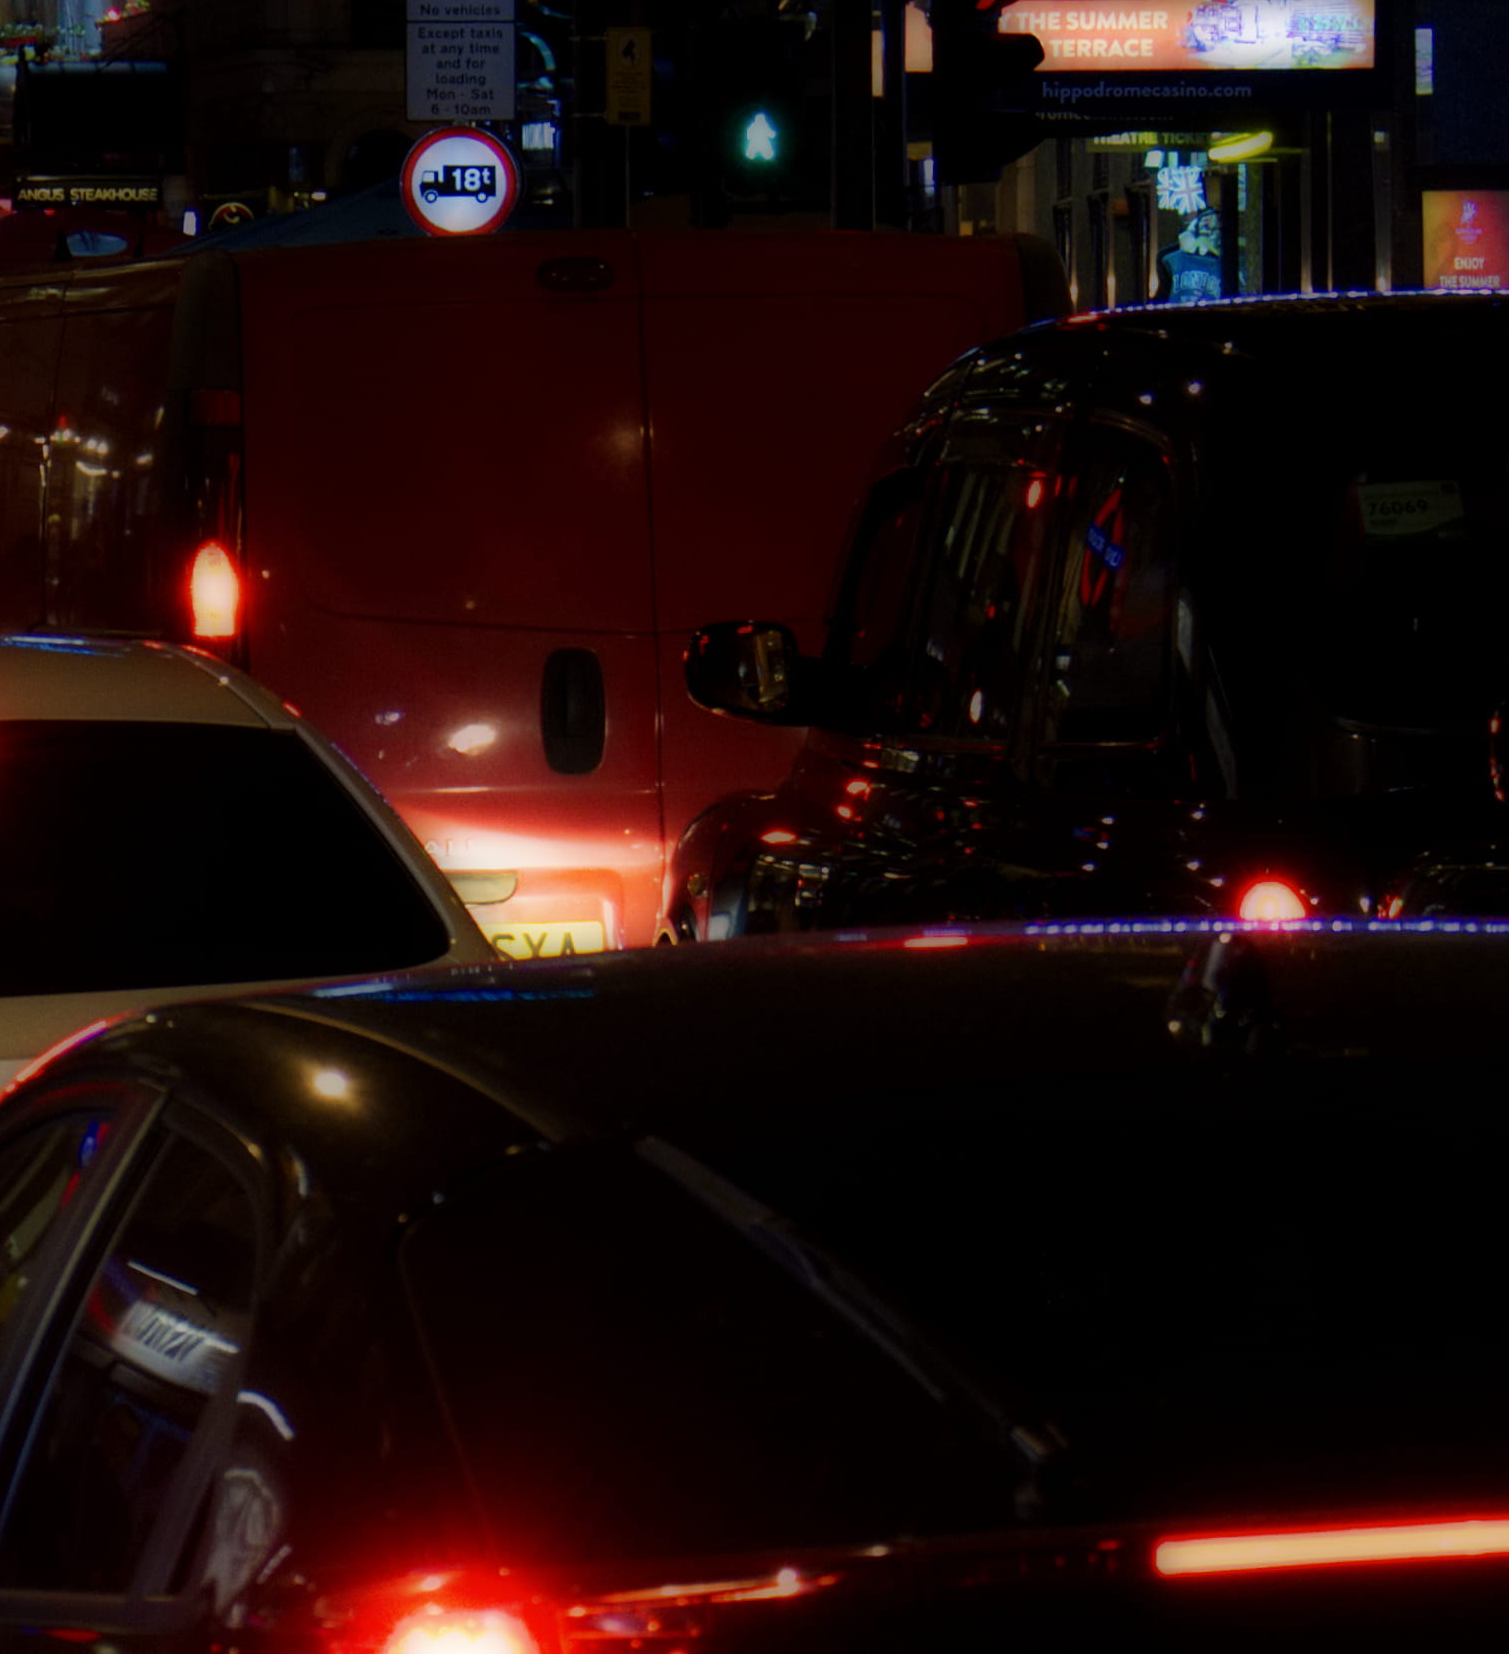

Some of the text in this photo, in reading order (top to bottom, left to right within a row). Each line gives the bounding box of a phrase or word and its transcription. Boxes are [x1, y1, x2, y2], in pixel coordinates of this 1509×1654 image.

[420, 4, 500, 16] No vehicles
[1016, 11, 1062, 30] THE
[1066, 11, 1169, 30] SUMMER
[418, 27, 503, 40] Except taxis
[422, 44, 500, 56] at any time
[1050, 39, 1155, 58] TERRACE
[437, 58, 486, 69] and for
[436, 74, 486, 86] loading
[426, 88, 455, 100] Mon
[471, 88, 495, 100] Sat
[1042, 80, 1252, 104] hippodromecasino.com
[432, 104, 440, 115] 6
[455, 104, 491, 115] 10am
[450, 166, 492, 193] 18t
[17, 187, 159, 203] ANGUS STEAKHOUSE
[1454, 257, 1485, 271] ENJOY
[1459, 274, 1501, 289] SUMMER
